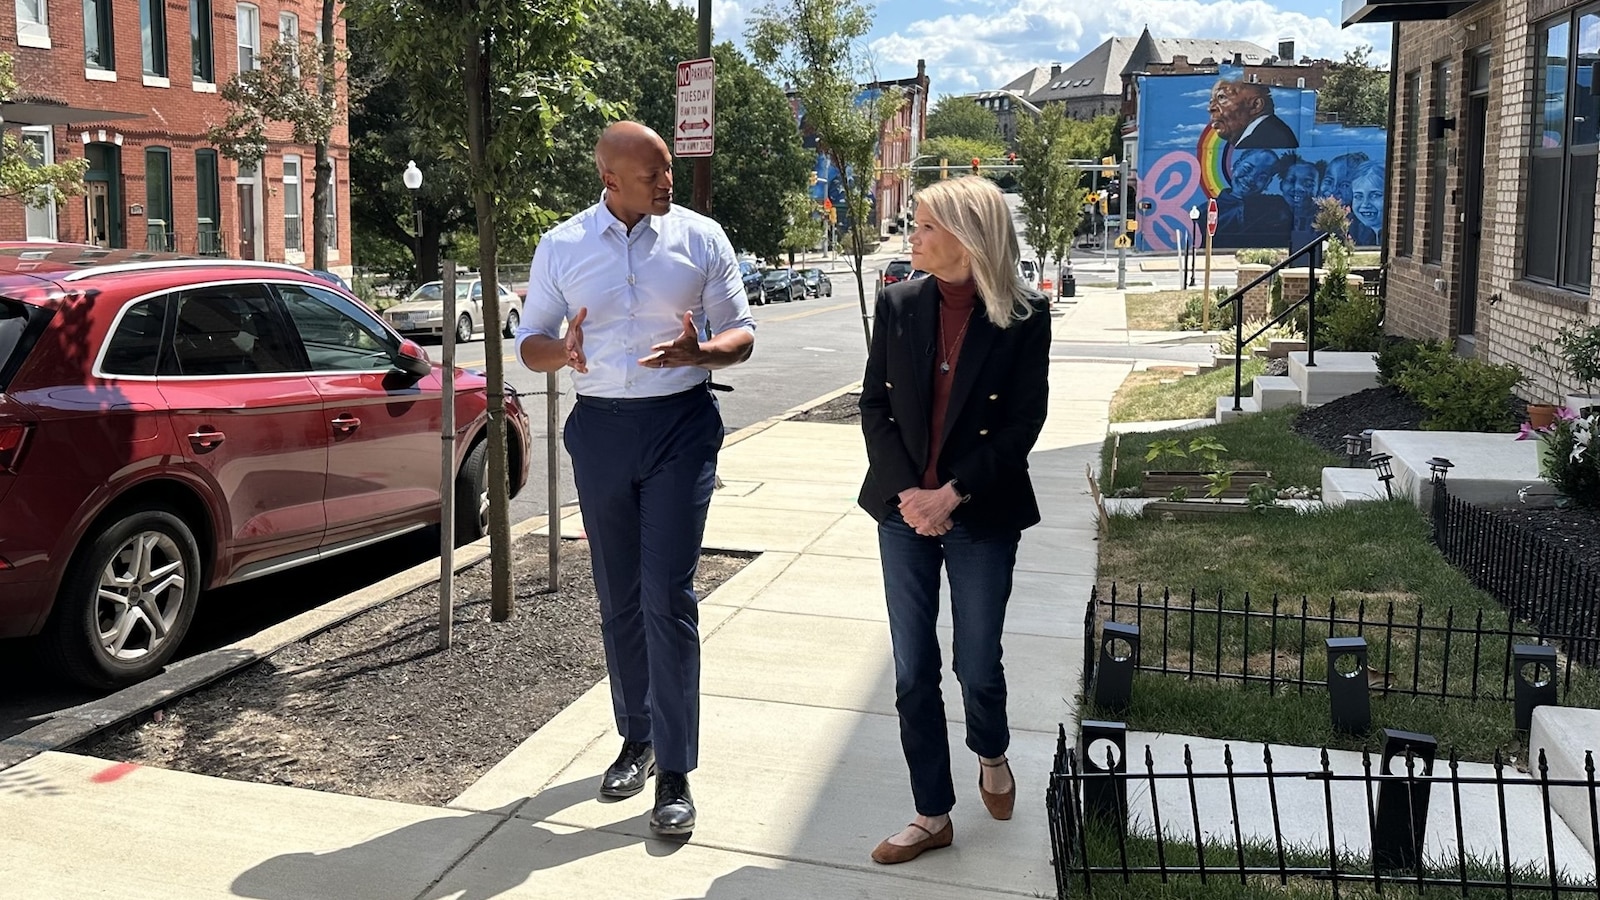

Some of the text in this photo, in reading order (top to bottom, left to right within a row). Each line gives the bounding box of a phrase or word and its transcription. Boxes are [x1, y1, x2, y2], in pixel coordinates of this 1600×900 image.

[679, 66, 712, 86] NO PARKING
[680, 89, 711, 102] TUESDAY
[691, 106, 697, 116] TO
[677, 142, 686, 151] TOW
[700, 140, 711, 150] ZONE
